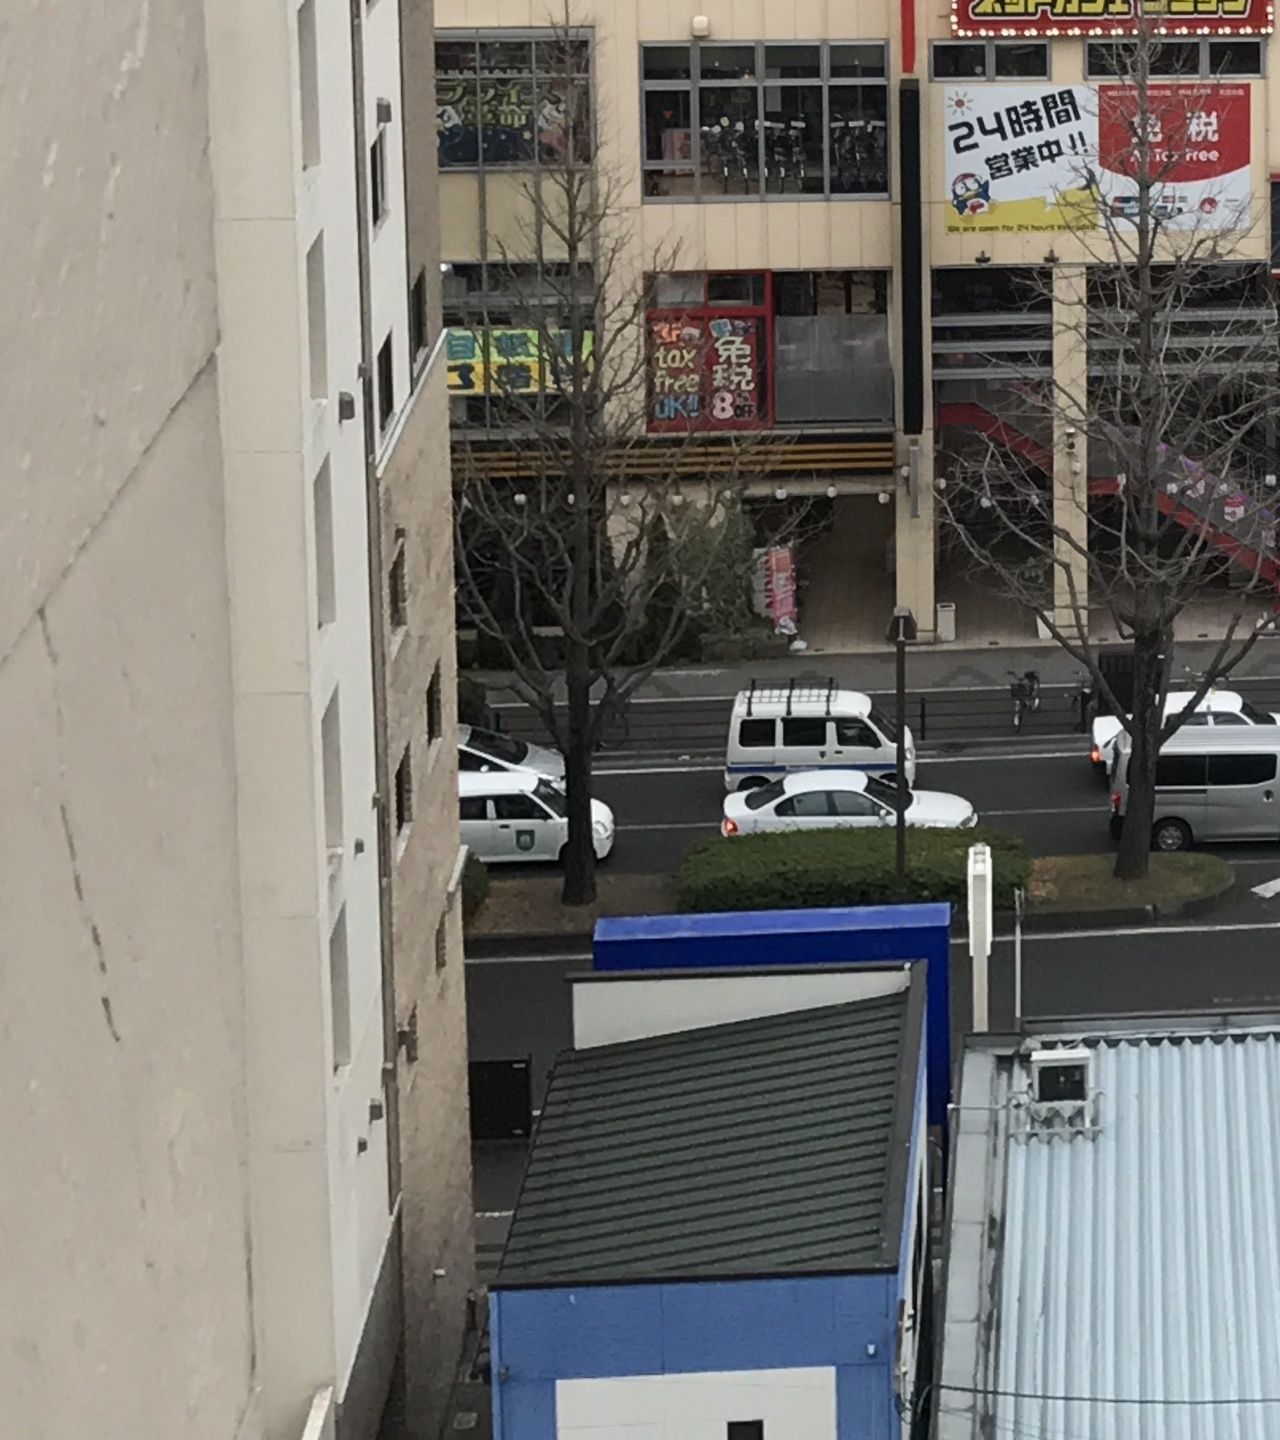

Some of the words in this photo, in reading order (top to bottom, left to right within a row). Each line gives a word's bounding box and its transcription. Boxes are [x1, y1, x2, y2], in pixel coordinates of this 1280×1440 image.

[948, 89, 1081, 154] 24時間
[655, 346, 697, 369] tax
[713, 336, 755, 391] 免税
[654, 369, 700, 393] free
